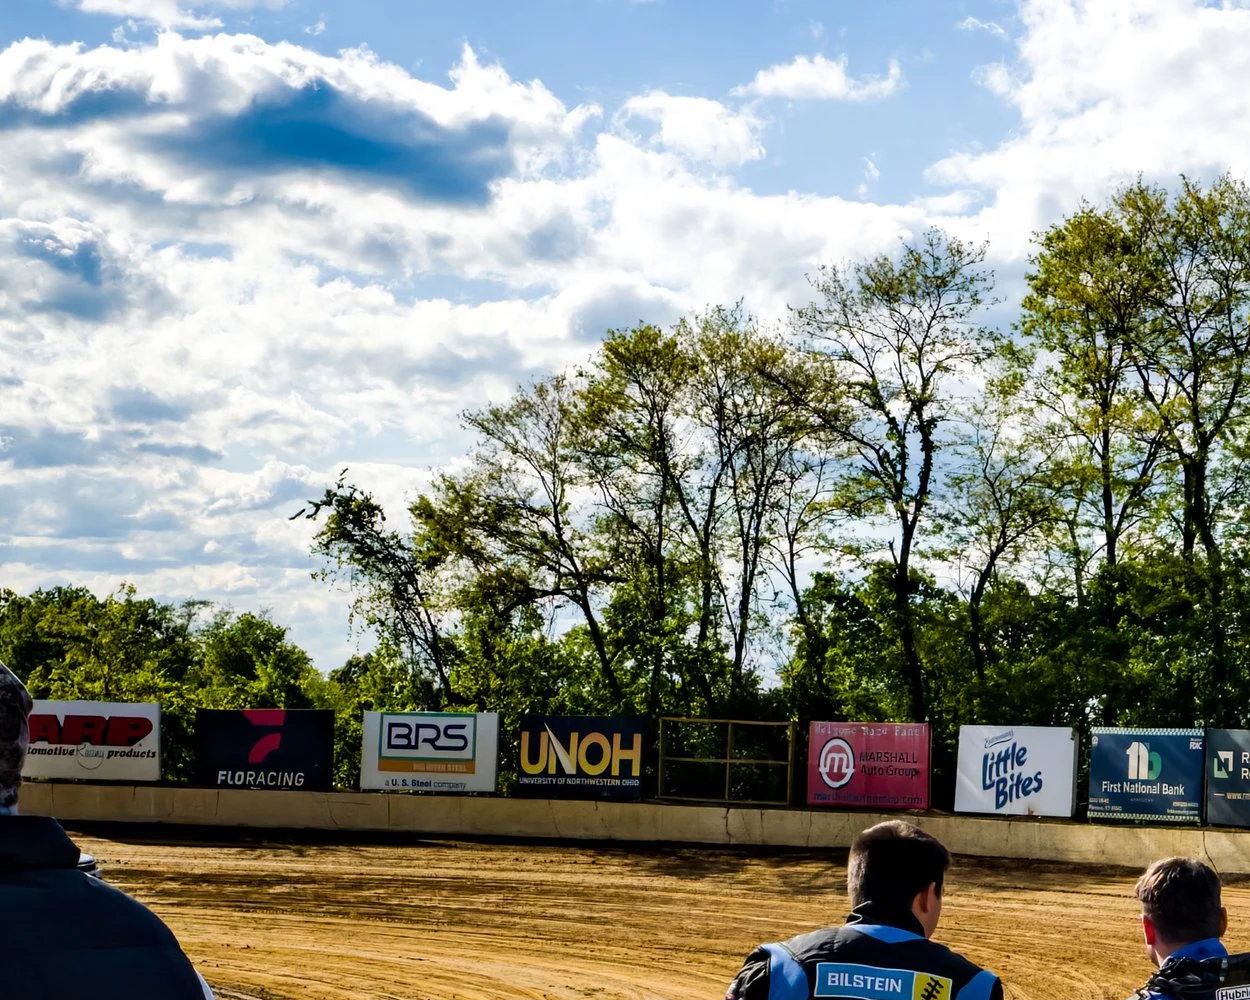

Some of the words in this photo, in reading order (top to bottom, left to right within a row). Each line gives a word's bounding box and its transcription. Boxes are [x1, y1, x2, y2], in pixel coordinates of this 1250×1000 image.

[28, 714, 153, 747] ARP
[387, 721, 469, 751] BRS
[27, 746, 75, 756] tomotive
[107, 748, 156, 760] products
[520, 722, 642, 777] UNOH
[859, 751, 918, 764] MARSHALL
[860, 765, 884, 776] Auto
[886, 765, 919, 779] Group
[982, 741, 1028, 791] Little
[217, 770, 305, 786] FLORACING
[411, 779, 432, 787] Steel
[519, 777, 557, 785] UNIVERSITY
[557, 777, 566, 785] OF
[566, 777, 621, 786] NORTHWESTERN
[995, 770, 1043, 810] Bites
[1101, 781, 1121, 793] First
[1123, 781, 1160, 794] National
[1162, 783, 1185, 796] Bank
[827, 972, 902, 993] BILSTEIN
